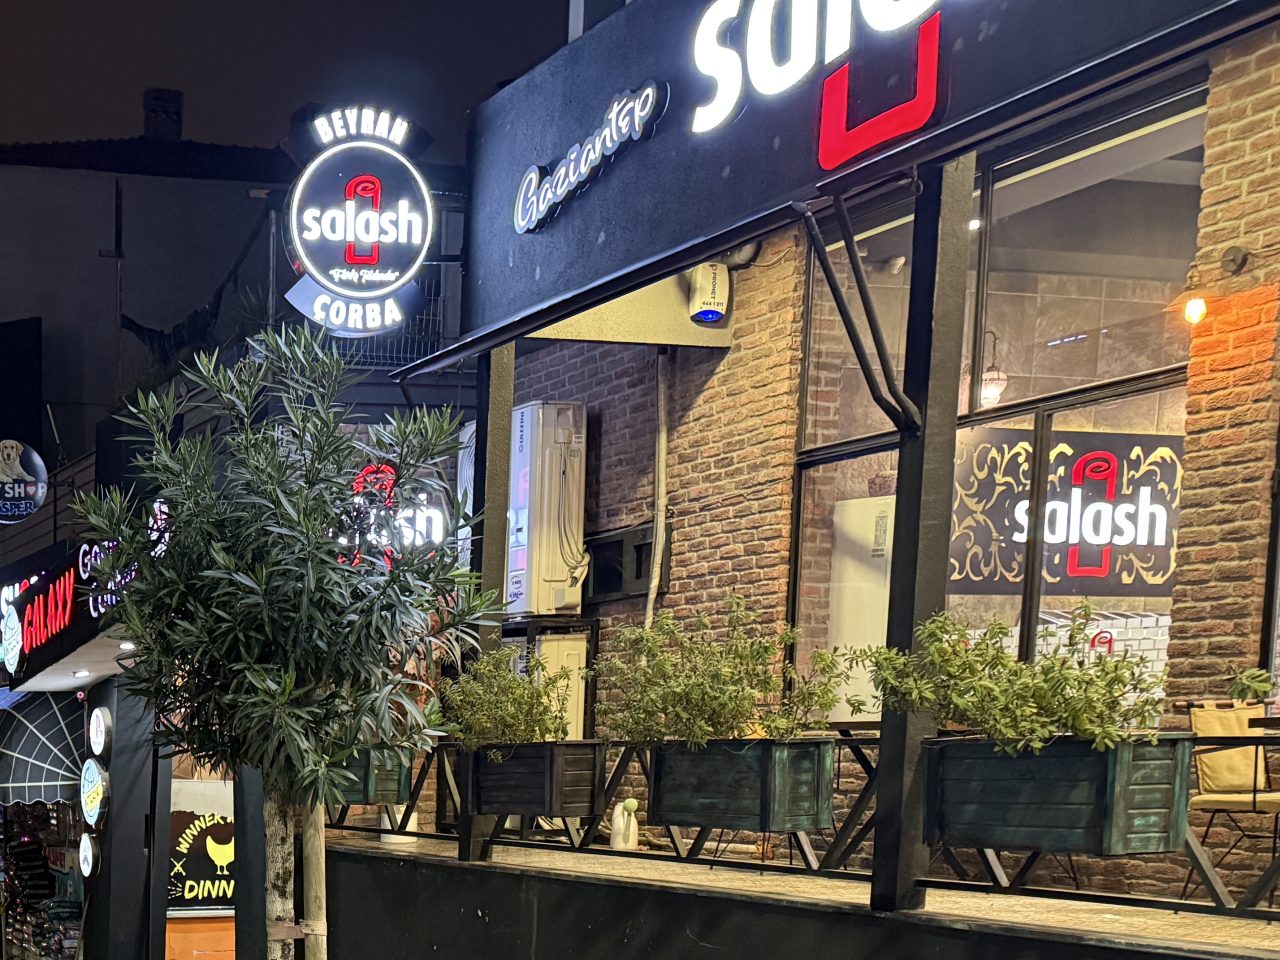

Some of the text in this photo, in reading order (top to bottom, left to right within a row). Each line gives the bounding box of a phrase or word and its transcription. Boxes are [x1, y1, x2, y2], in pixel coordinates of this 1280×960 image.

[314, 108, 409, 145] BEYRAN
[517, 87, 653, 227] Gaziantep
[302, 200, 422, 244] salash
[1012, 486, 1168, 546] salash
[23, 567, 75, 654] GALAXY
